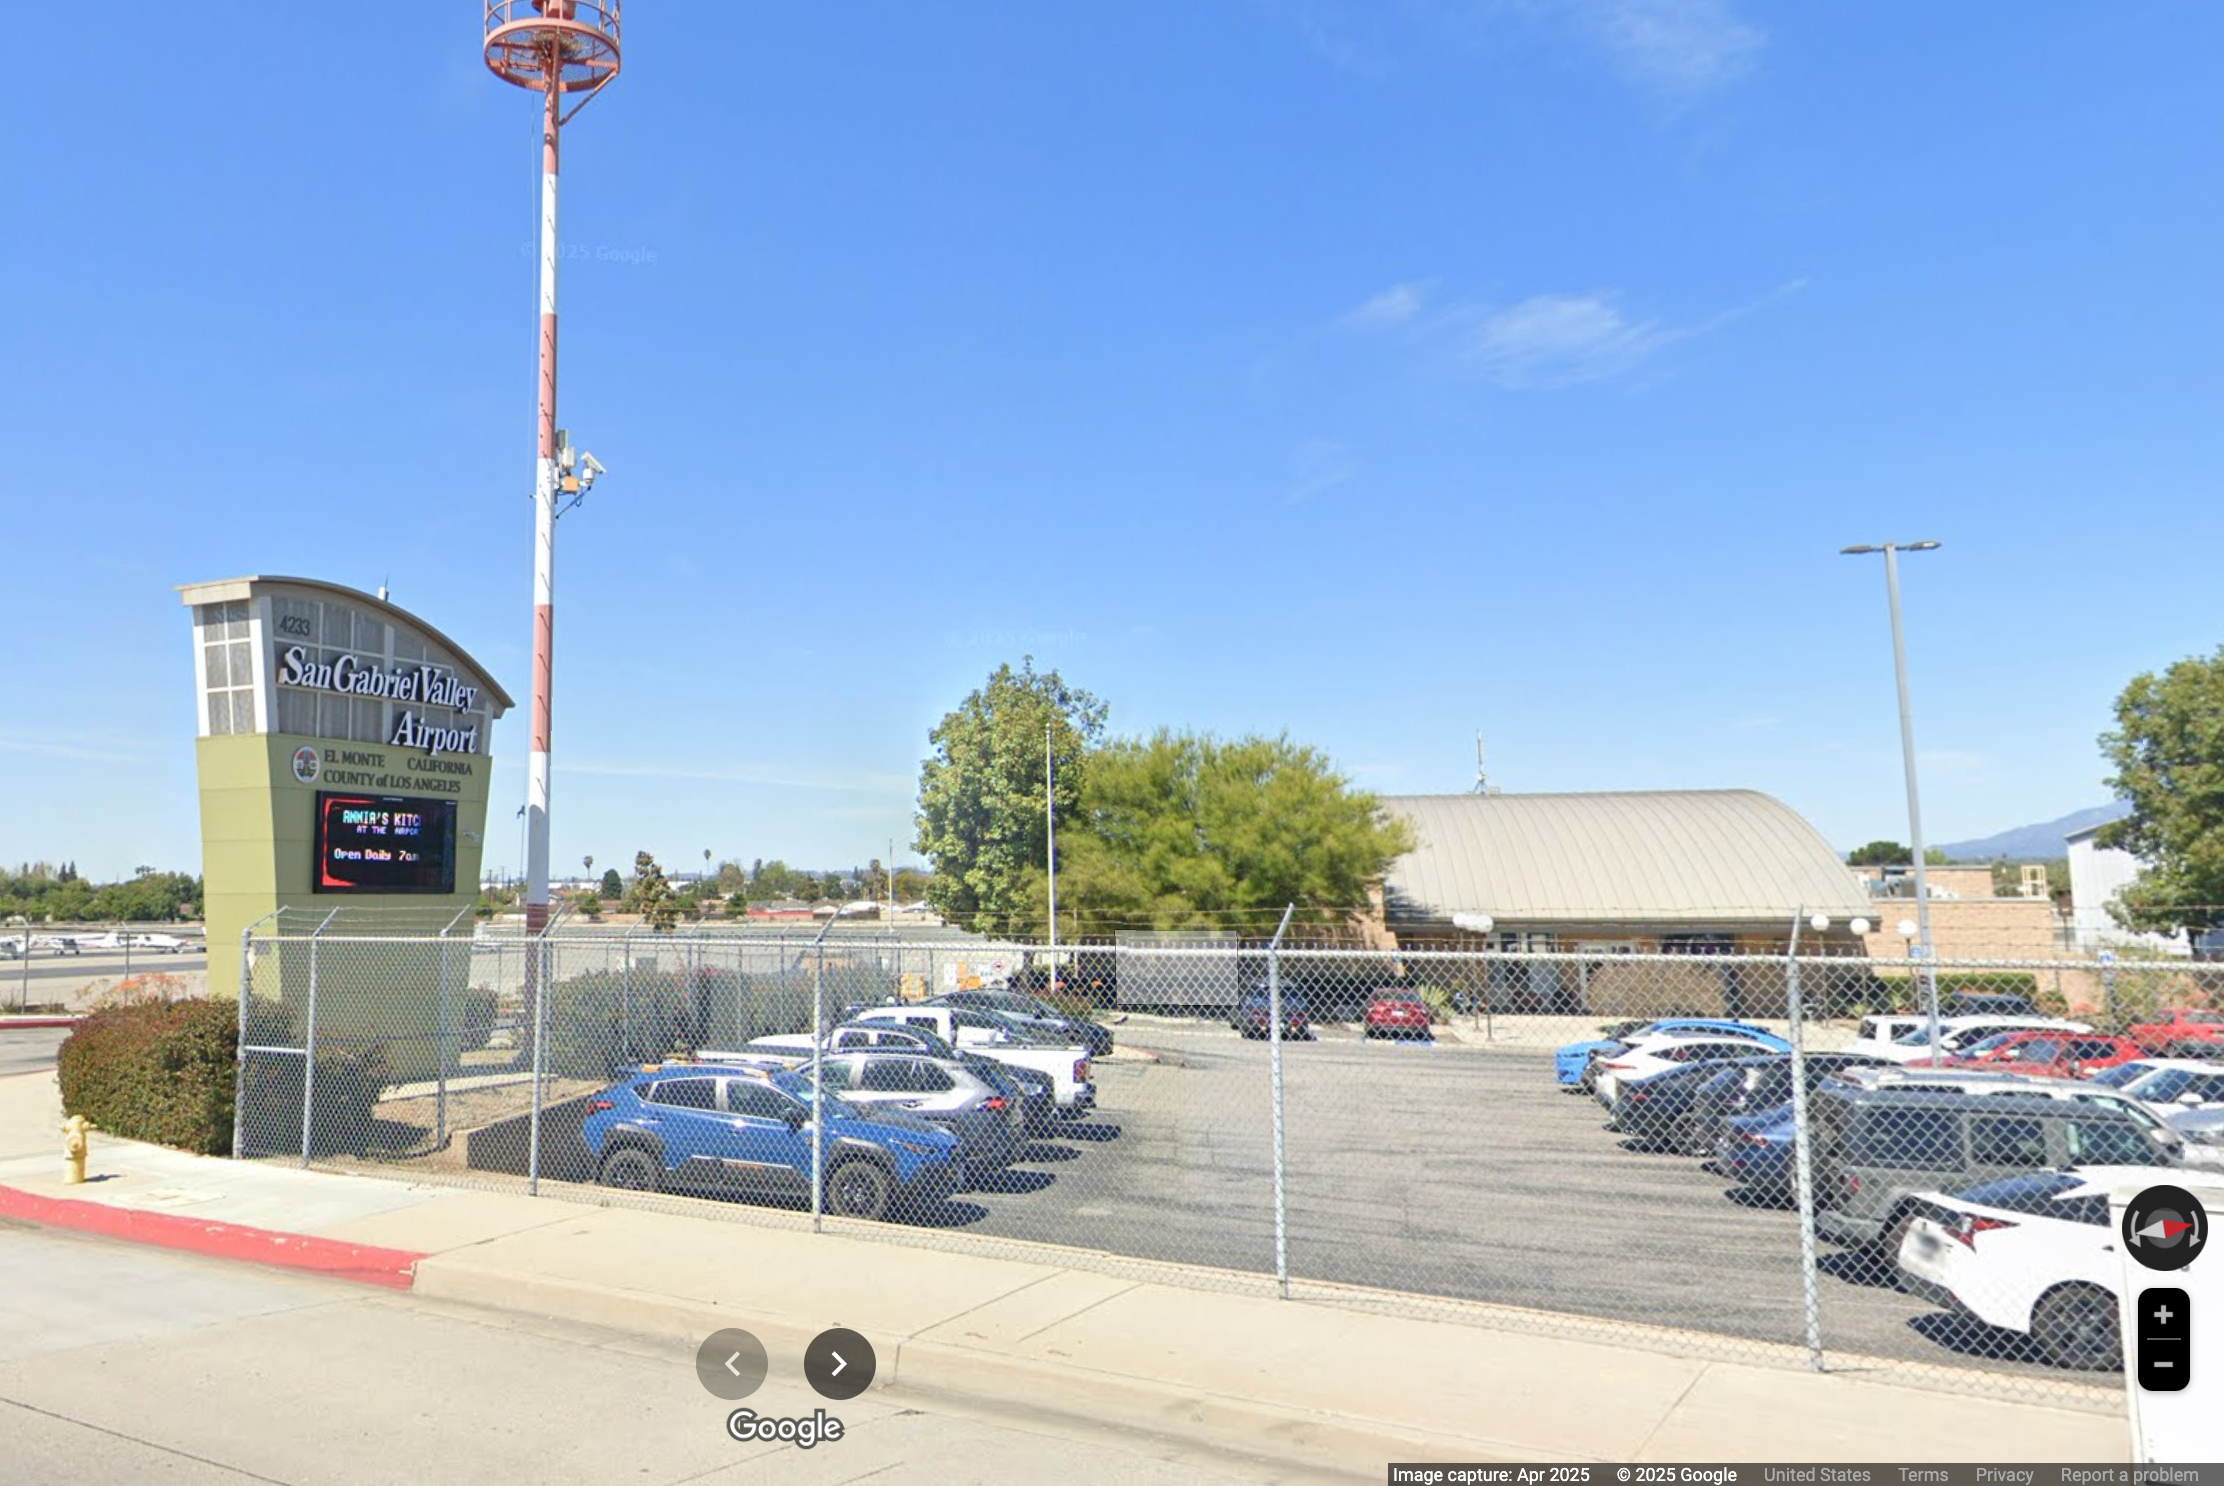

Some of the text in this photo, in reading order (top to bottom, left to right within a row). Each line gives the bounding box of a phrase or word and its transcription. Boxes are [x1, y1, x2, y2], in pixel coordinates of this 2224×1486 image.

[280, 615, 310, 637] 4233
[280, 646, 478, 714] San Gabriel Valley
[391, 711, 478, 756] Airport
[324, 749, 473, 776] EL MONTE CALIFORNIA
[323, 769, 461, 794] COUNTY of LOS ANGELES
[356, 825, 368, 834] AT
[372, 826, 387, 835] THE
[334, 847, 361, 861] Open
[365, 848, 391, 862] Daily
